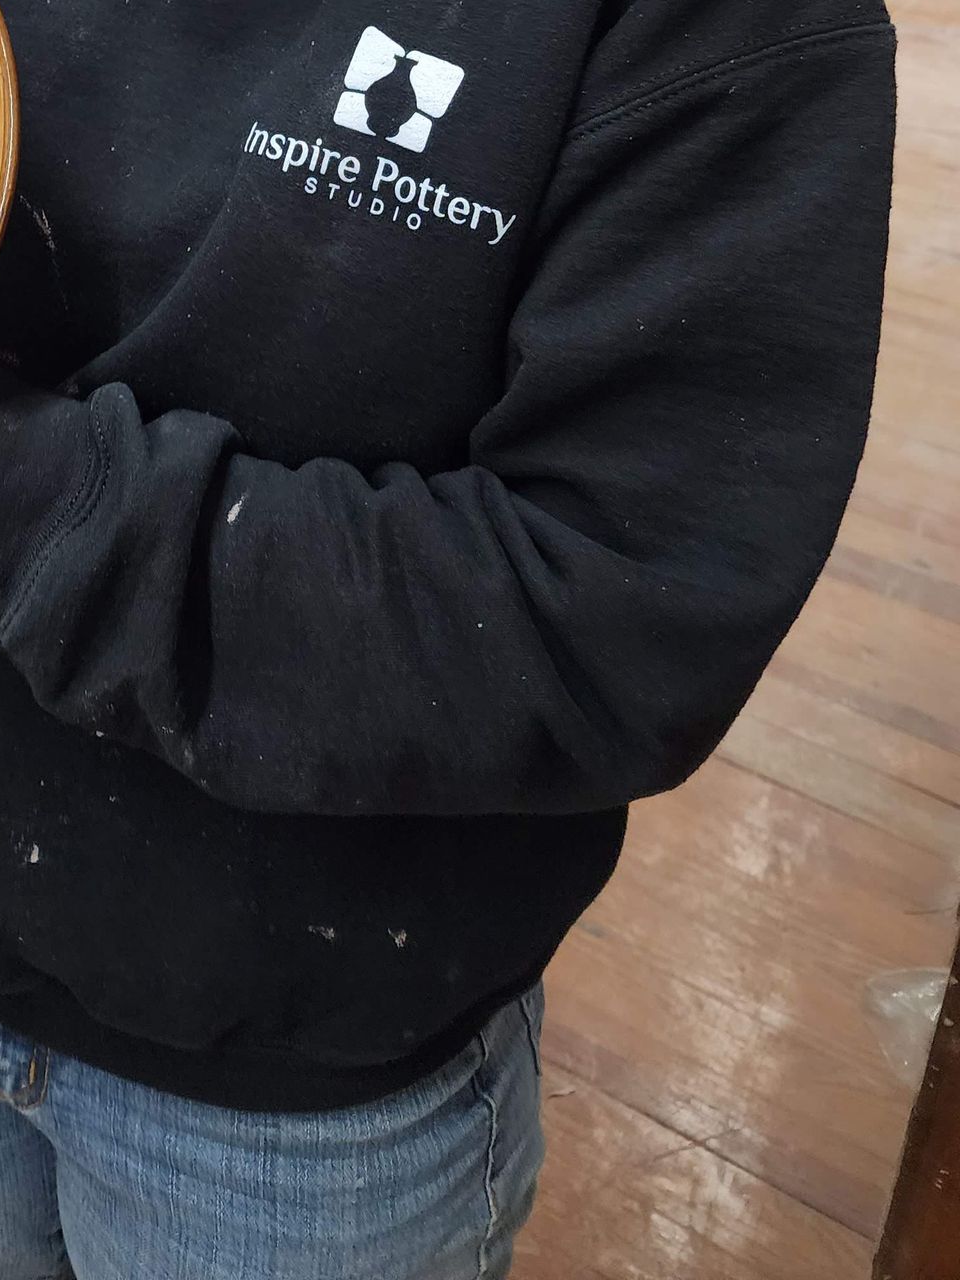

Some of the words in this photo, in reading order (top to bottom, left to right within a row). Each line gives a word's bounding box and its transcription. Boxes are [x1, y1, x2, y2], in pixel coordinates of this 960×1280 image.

[243, 121, 361, 183] Inspire
[372, 156, 517, 245] Pottery
[304, 176, 422, 231] STUDIO
